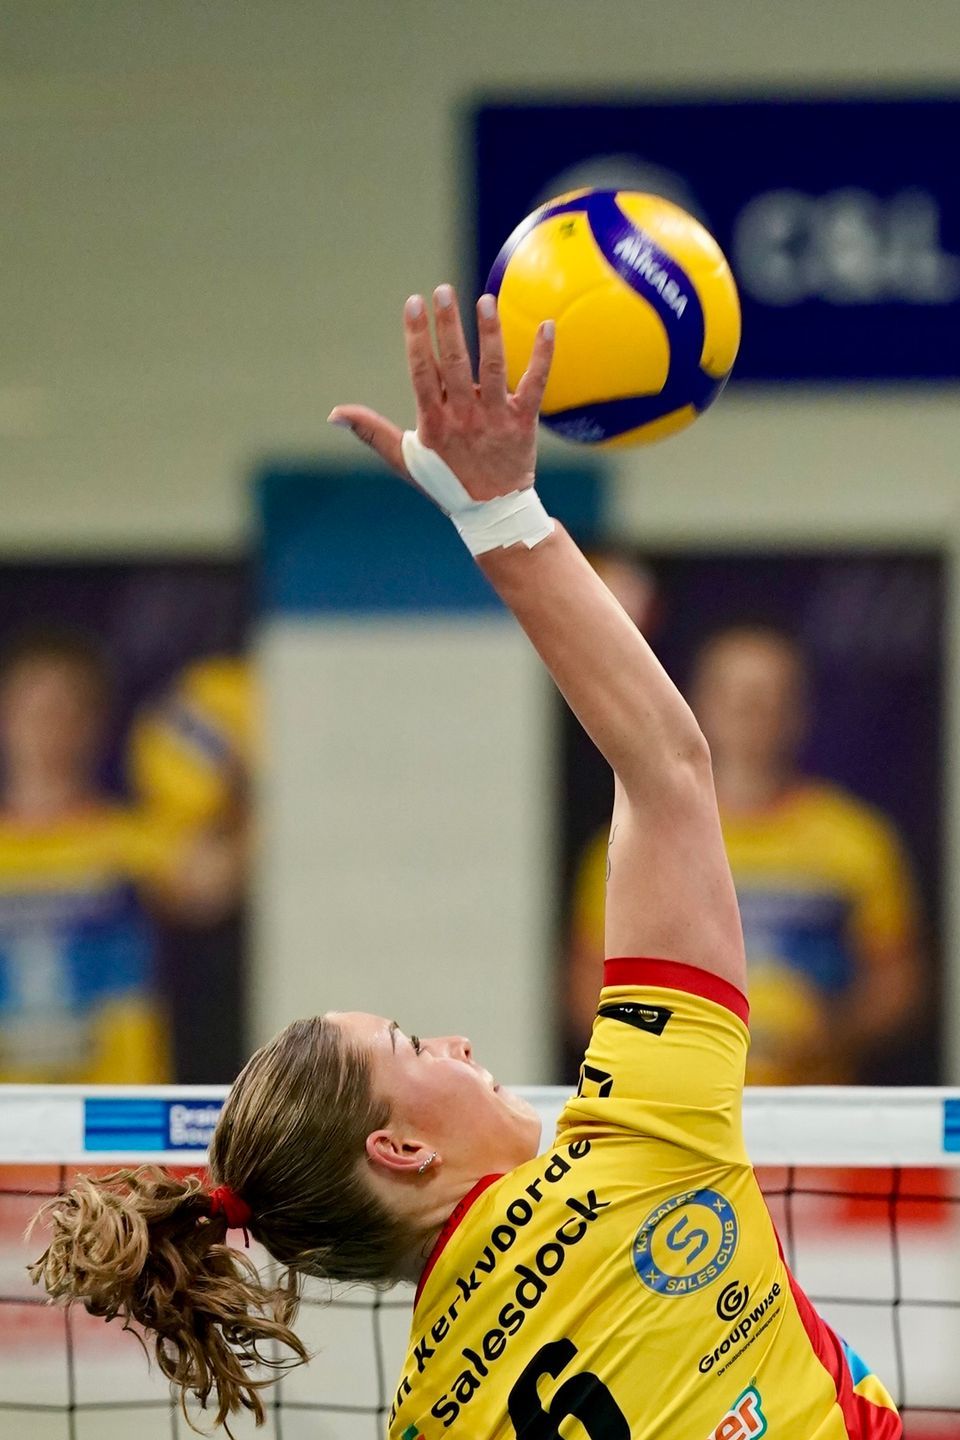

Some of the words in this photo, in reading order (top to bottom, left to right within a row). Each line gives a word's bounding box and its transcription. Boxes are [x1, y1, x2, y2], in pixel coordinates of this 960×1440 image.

[613, 235, 689, 320] MIKASA
[666, 1264, 718, 1292] SALES
[716, 1219, 734, 1264] CLUB
[430, 1189, 611, 1428] Salesdock
[698, 1282, 782, 1374] Groupwise
